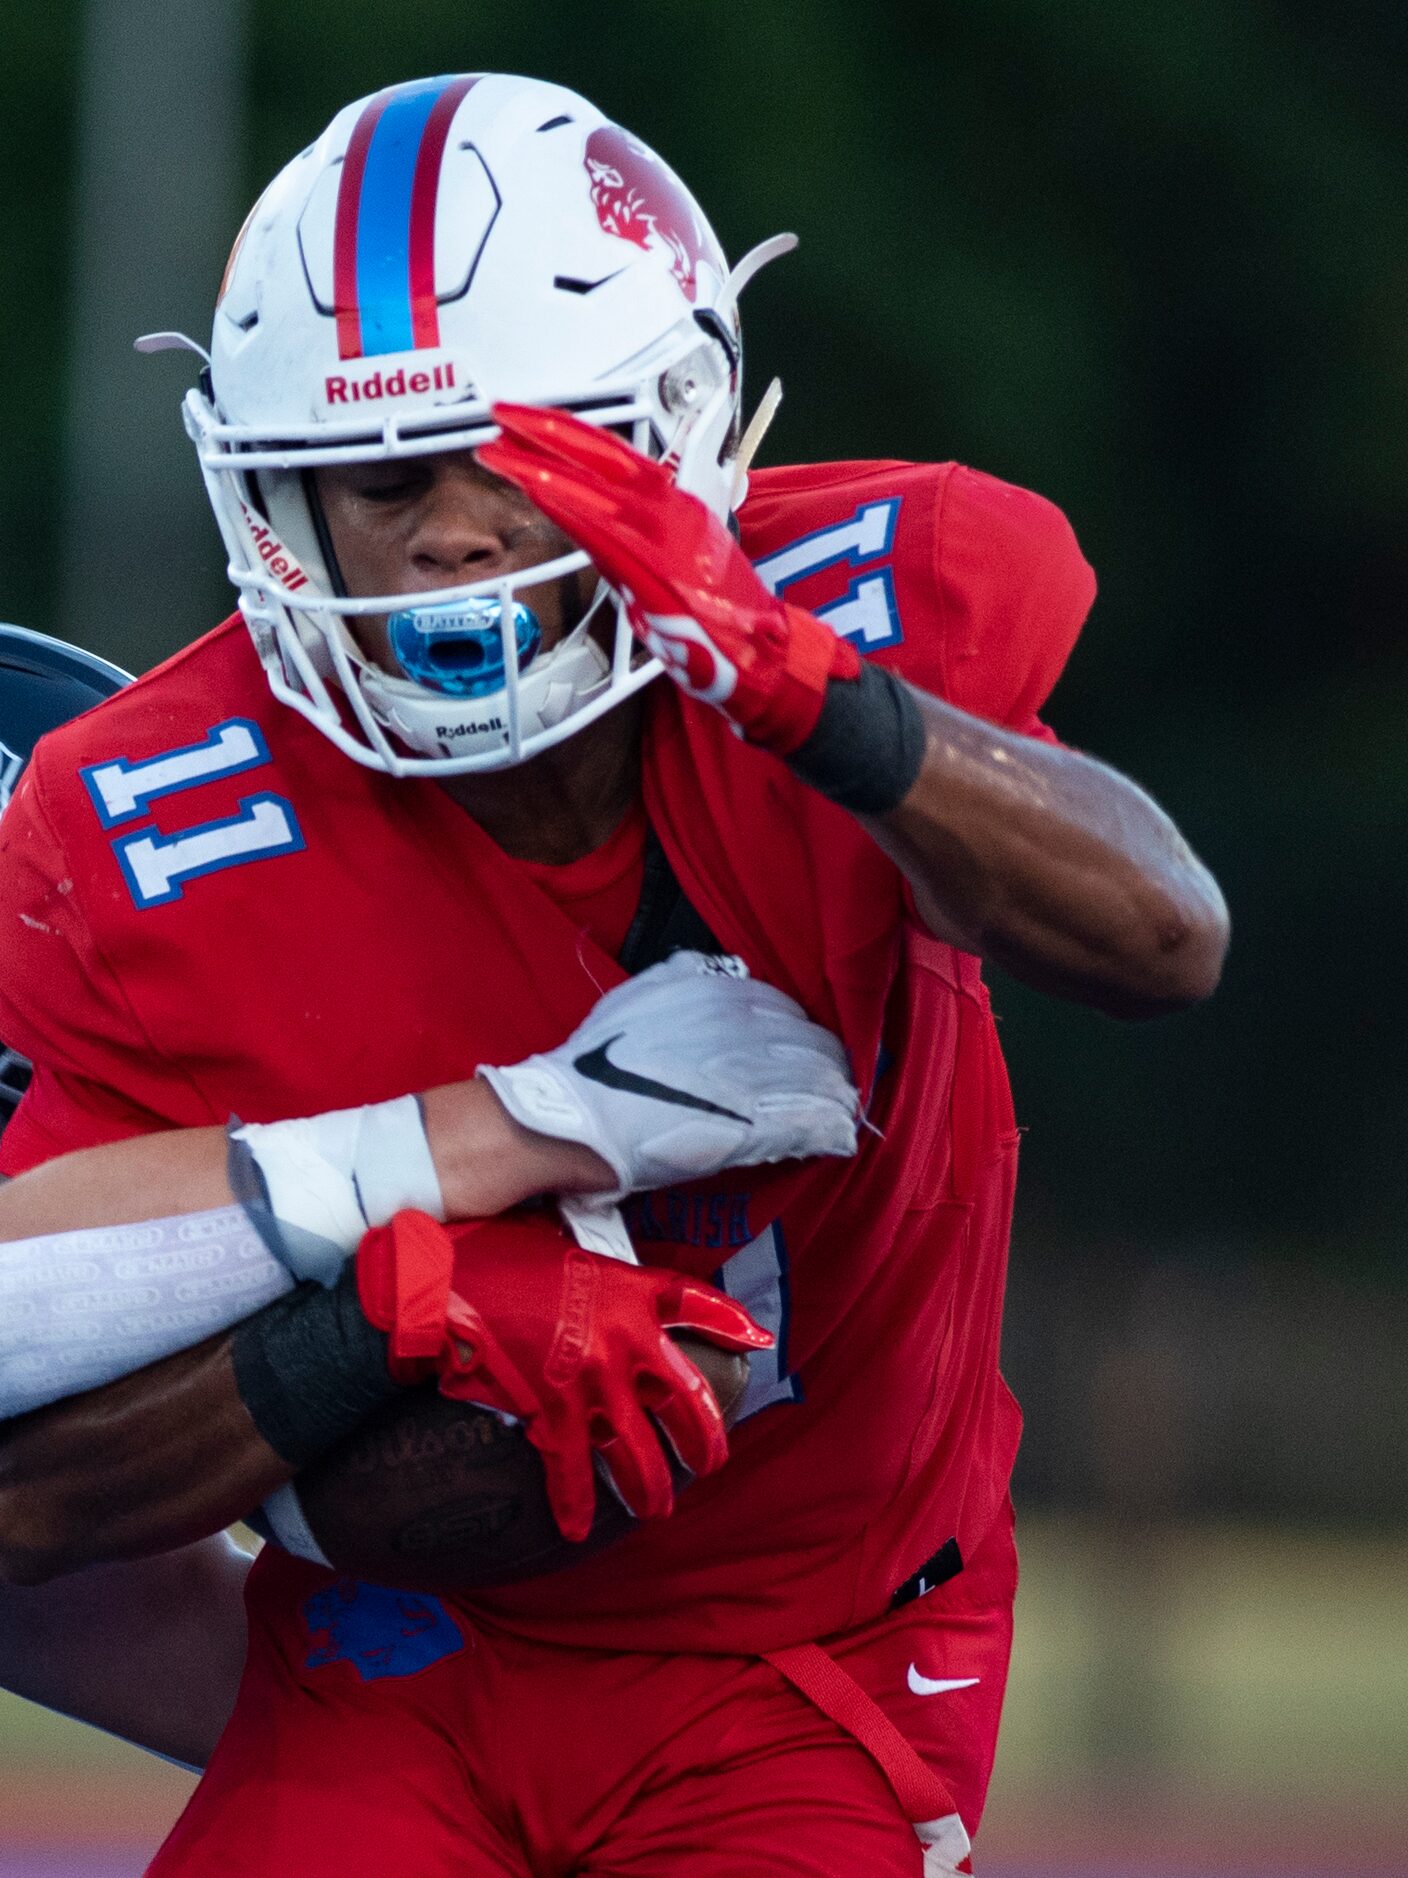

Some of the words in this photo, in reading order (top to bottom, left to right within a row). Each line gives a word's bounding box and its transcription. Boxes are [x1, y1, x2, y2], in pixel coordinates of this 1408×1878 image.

[325, 361, 457, 406] Riddell
[239, 499, 309, 592] ddell
[79, 716, 306, 912] 11
